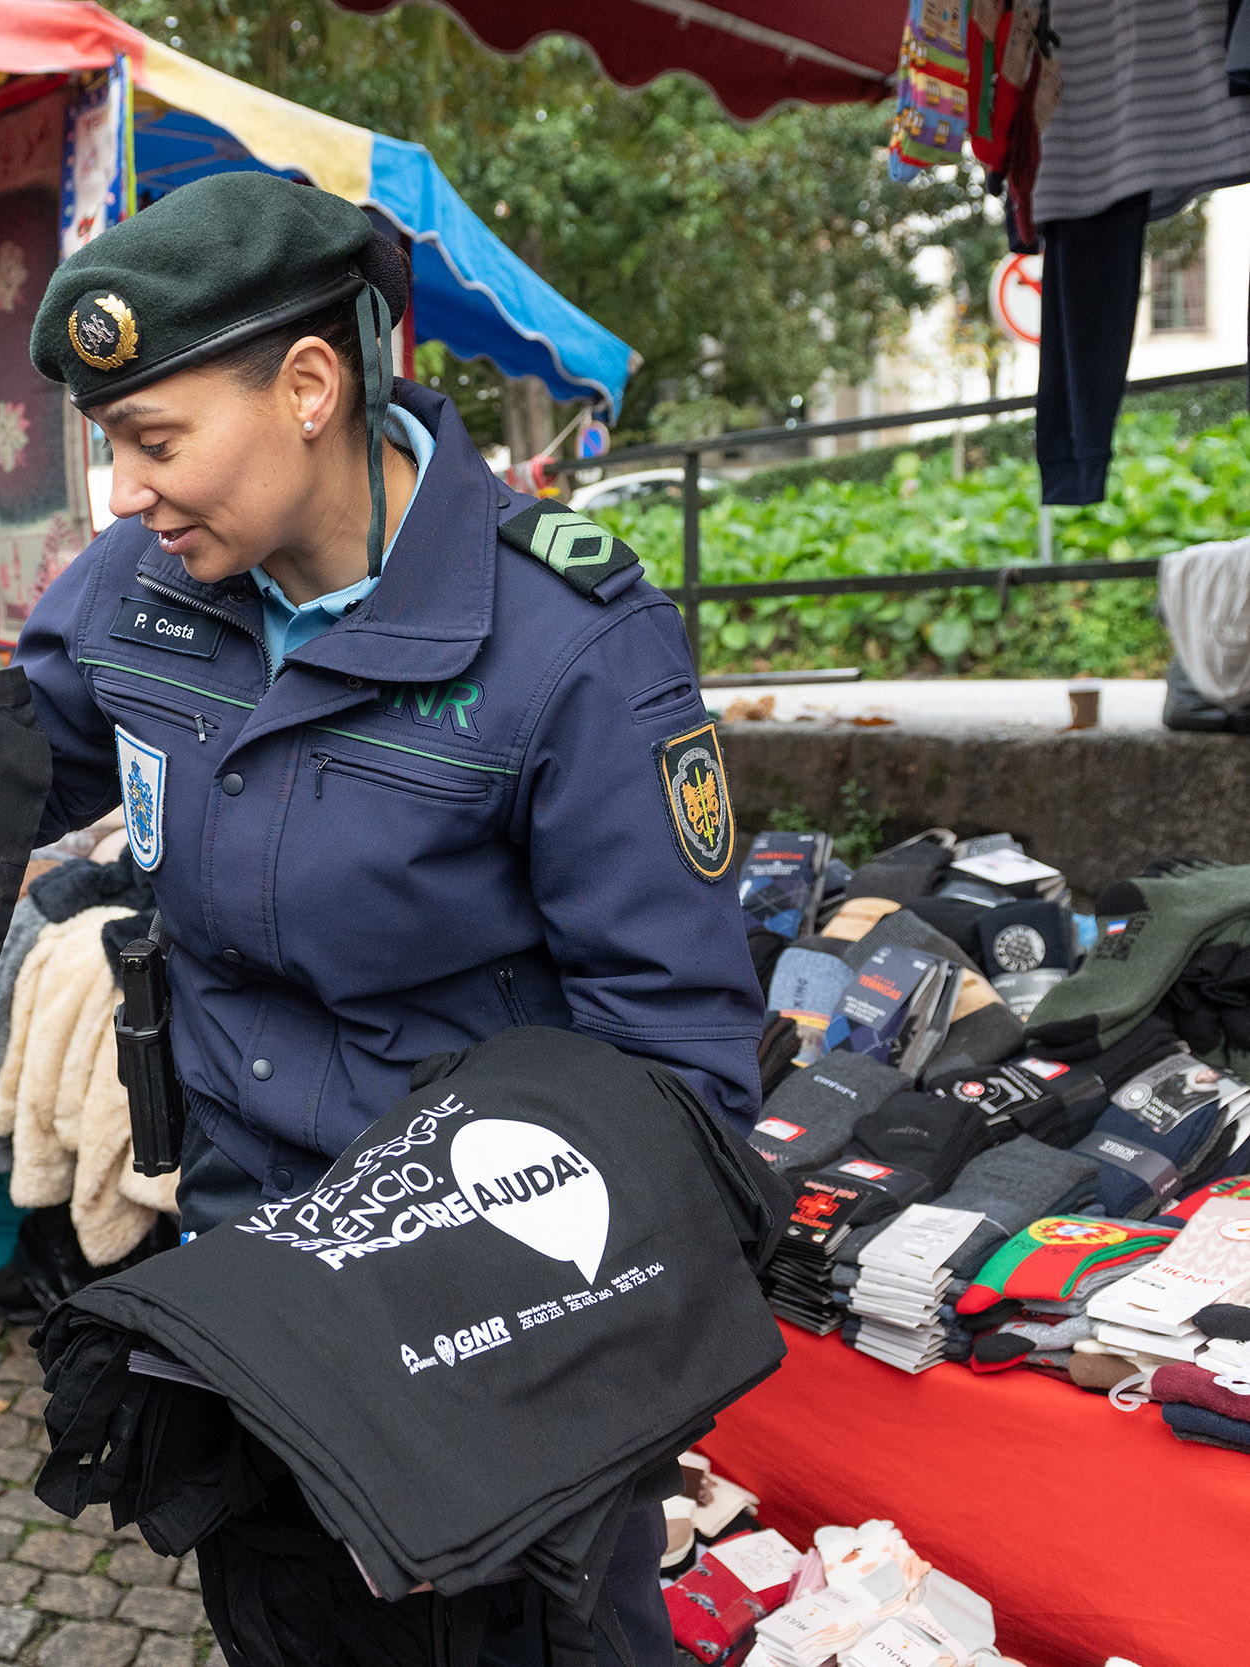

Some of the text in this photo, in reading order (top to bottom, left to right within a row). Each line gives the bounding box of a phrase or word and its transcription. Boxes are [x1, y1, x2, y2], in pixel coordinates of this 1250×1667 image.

[134, 613, 195, 640] P. Costa
[315, 1150, 591, 1272] PROCURE AJUDA!
[265, 1231, 300, 1242] O
[616, 1262, 664, 1293] 255 732 104
[567, 1288, 614, 1312] 255 410 260
[520, 1305, 565, 1331] 255 420 233
[453, 1316, 511, 1353] GNR
[781, 1614, 810, 1631] MULU
